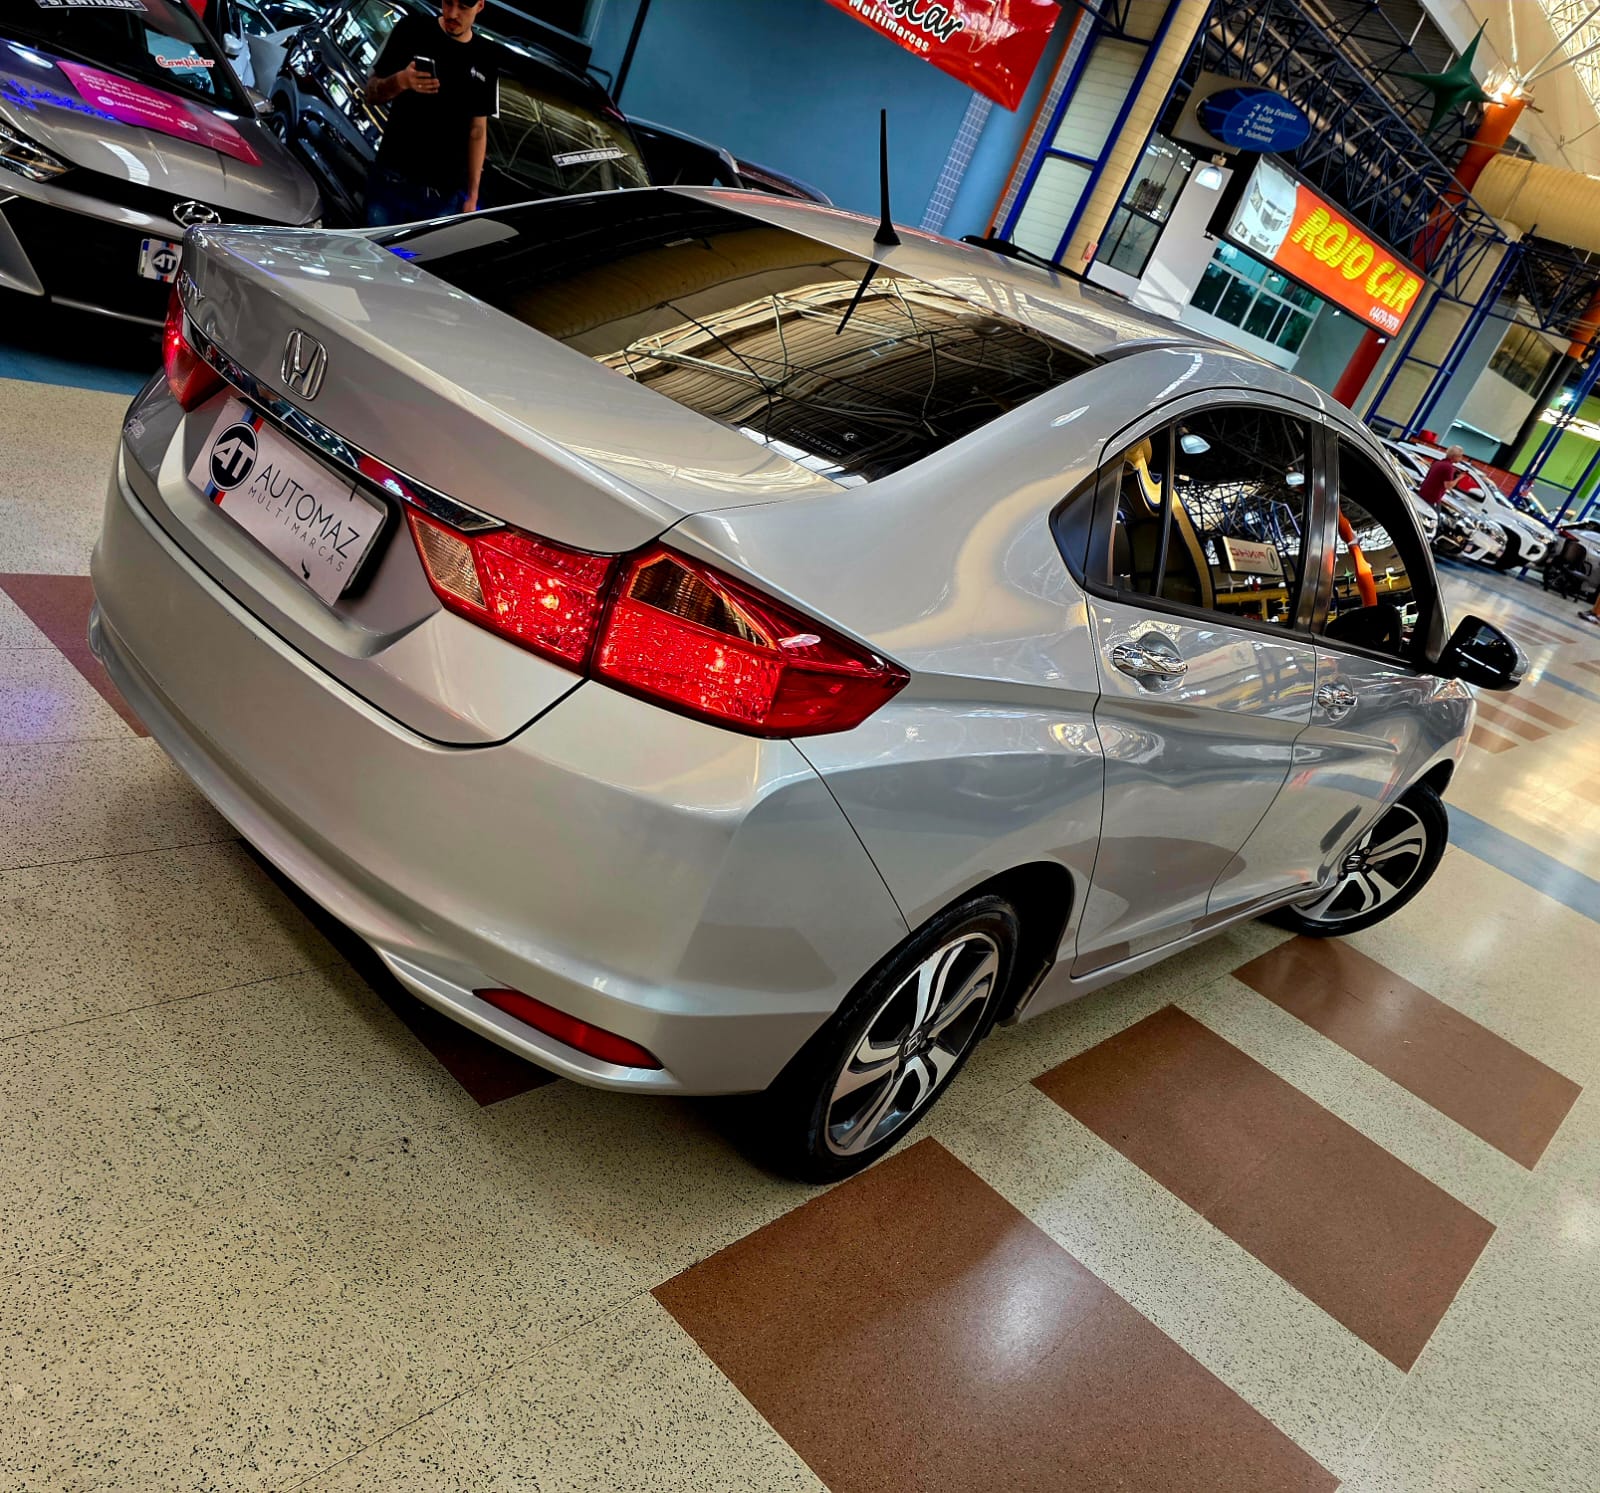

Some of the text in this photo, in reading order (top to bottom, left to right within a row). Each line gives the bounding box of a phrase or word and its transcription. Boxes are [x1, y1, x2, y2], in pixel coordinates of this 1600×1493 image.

[848, 0, 930, 52] Multimarcas
[1291, 206, 1419, 314] ROJO CAR
[247, 485, 345, 573] MULTIMARCAS
[254, 463, 361, 560] AUTOMAZ
